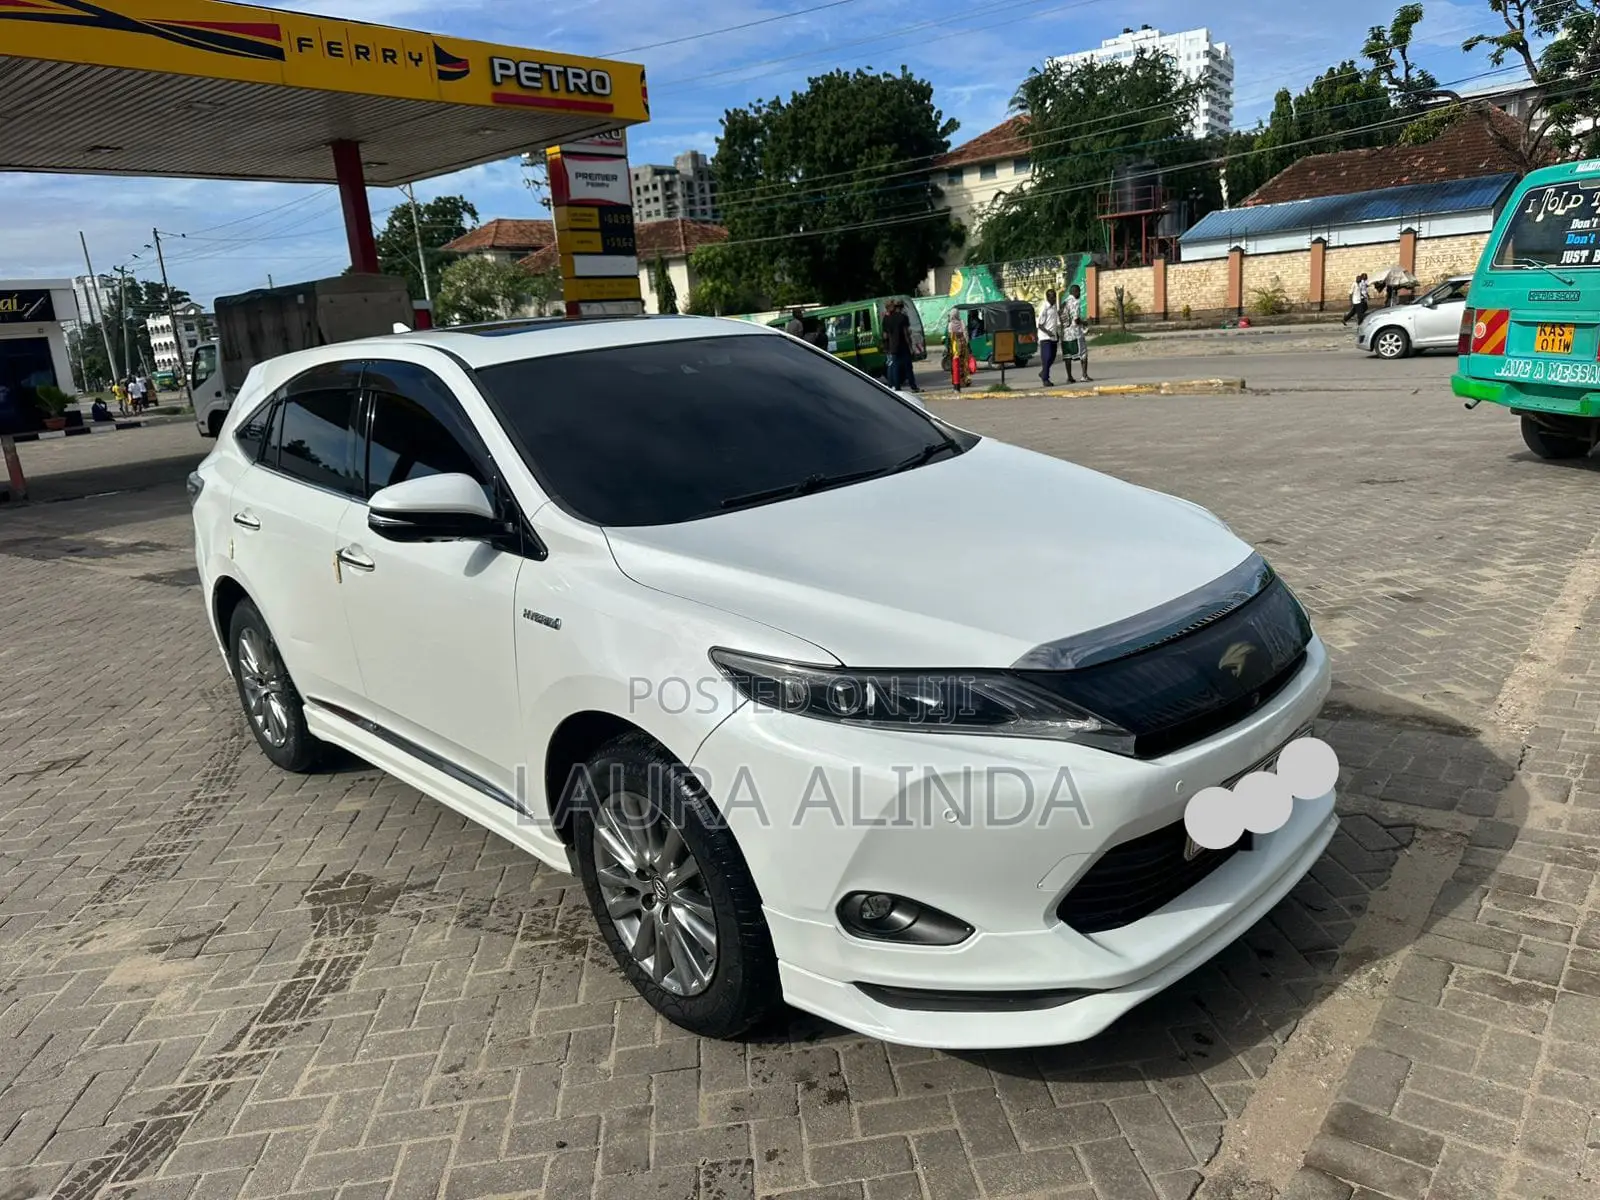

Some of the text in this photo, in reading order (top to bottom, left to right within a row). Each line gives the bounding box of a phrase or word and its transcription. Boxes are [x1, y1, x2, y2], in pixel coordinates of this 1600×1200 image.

[297, 36, 424, 67] FERRY
[491, 55, 613, 97] PETRO
[575, 171, 618, 182] PREMIER
[1525, 199, 1537, 213] I
[1535, 188, 1584, 222] TOLD
[1570, 218, 1598, 230] Don't
[1565, 232, 1596, 245] Don't
[1560, 250, 1590, 264] JUST
[1539, 323, 1565, 337] KAS
[1541, 338, 1571, 352] 011W
[1533, 361, 1544, 379] A
